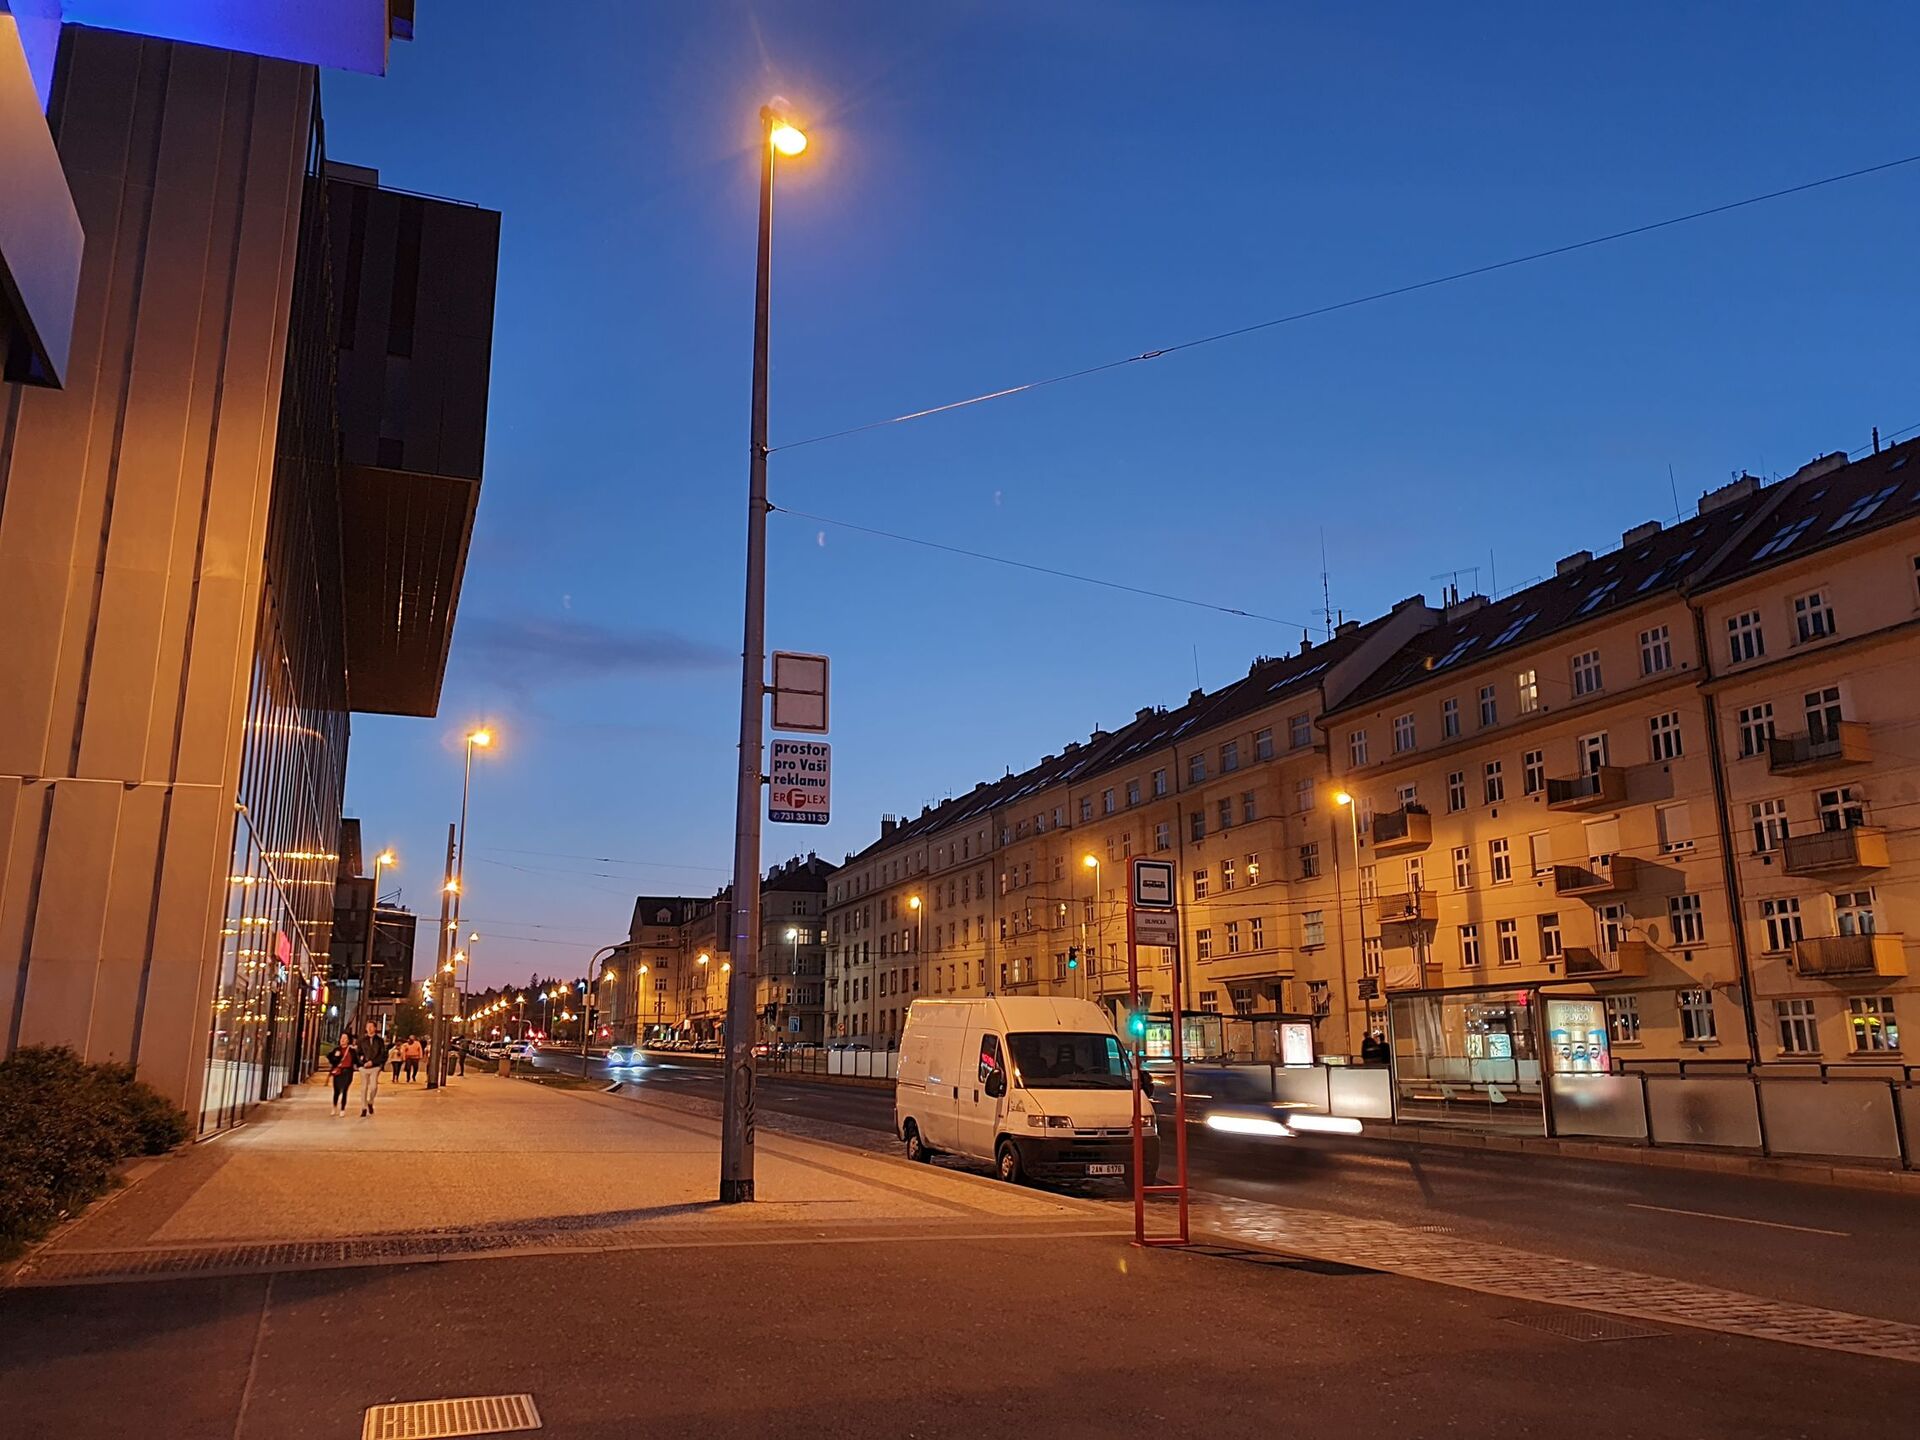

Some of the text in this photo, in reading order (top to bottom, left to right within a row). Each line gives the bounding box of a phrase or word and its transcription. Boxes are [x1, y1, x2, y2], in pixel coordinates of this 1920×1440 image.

[775, 743, 827, 757] prostor
[774, 758, 827, 772] pro Vaši
[774, 772, 826, 787] reklamu
[773, 788, 826, 808] ERFLEX
[781, 812, 828, 822] 731 33 11 33
